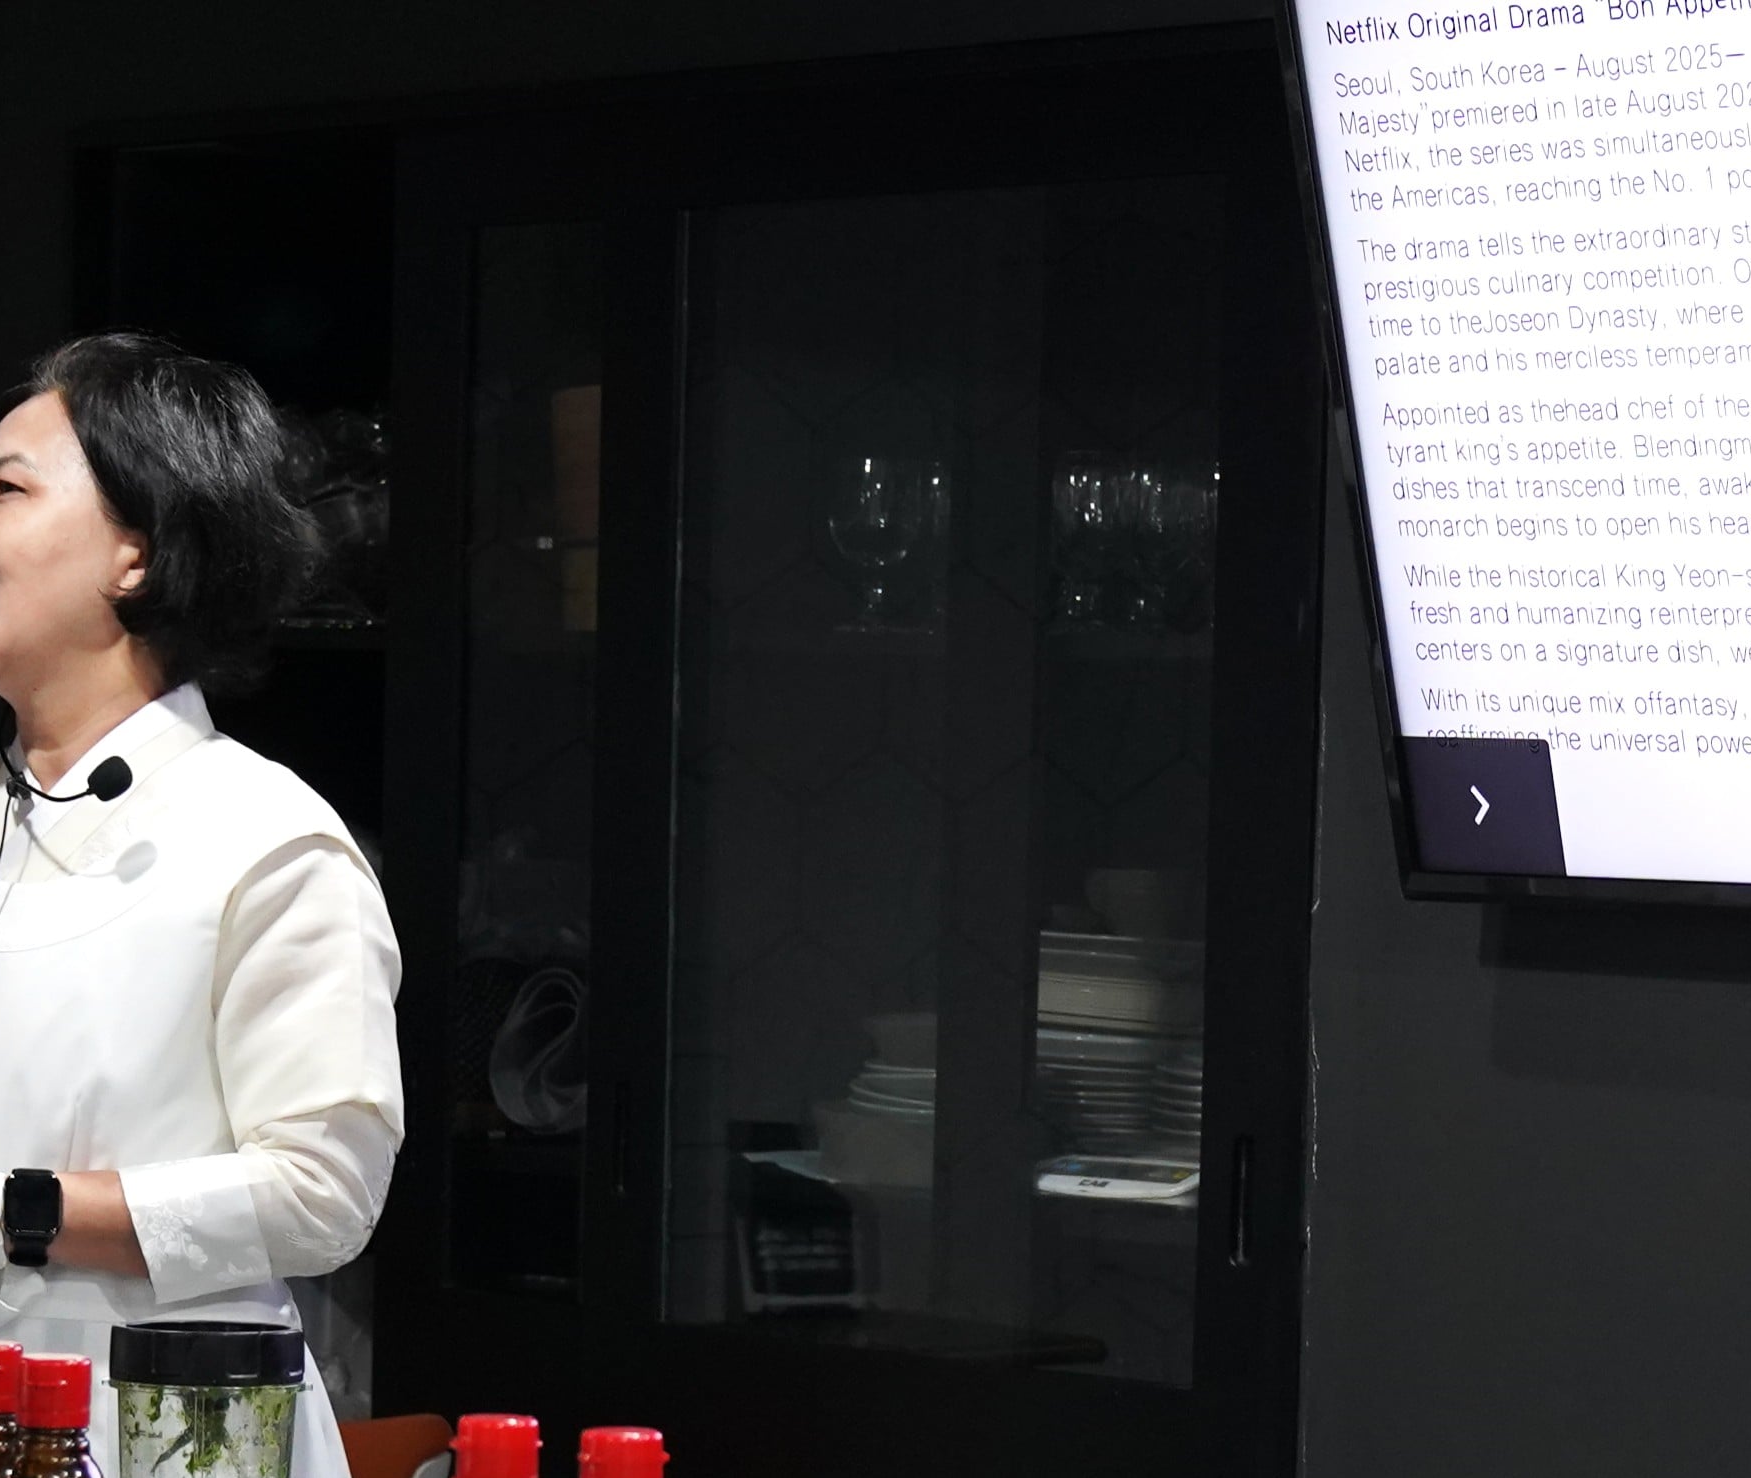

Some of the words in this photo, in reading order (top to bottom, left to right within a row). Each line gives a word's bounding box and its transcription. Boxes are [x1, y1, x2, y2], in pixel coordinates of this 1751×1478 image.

[1325, 17, 1400, 46] Netflix
[1407, 8, 1499, 41] Original
[1509, 3, 1586, 31] Drama
[1408, 63, 1475, 93] South
[1479, 59, 1546, 87] Korea
[1575, 49, 1656, 82] August
[1427, 142, 1464, 169] the
[1468, 141, 1535, 166] series
[1540, 138, 1587, 161] was
[1349, 186, 1385, 214] the
[1505, 175, 1603, 203] reaching
[1608, 170, 1646, 197] the
[1652, 167, 1694, 194] No.
[1373, 351, 1442, 382] palate
[1447, 348, 1490, 375] and
[1494, 347, 1529, 372] his
[1534, 344, 1639, 371] merciless
[1385, 439, 1449, 469] tyrant
[1408, 599, 1463, 625] fresh
[1468, 601, 1510, 626] and
[1515, 600, 1643, 631] humanizing
[1414, 638, 1494, 663] centers
[1499, 642, 1528, 663] on
[1534, 642, 1548, 663] a
[1555, 638, 1660, 668] signature
[1419, 687, 1469, 713] With
[1474, 687, 1502, 714] its
[1507, 689, 1583, 719] unique
[1588, 694, 1627, 715] mix
[1546, 728, 1582, 752] the
[1588, 728, 1687, 754] universal
